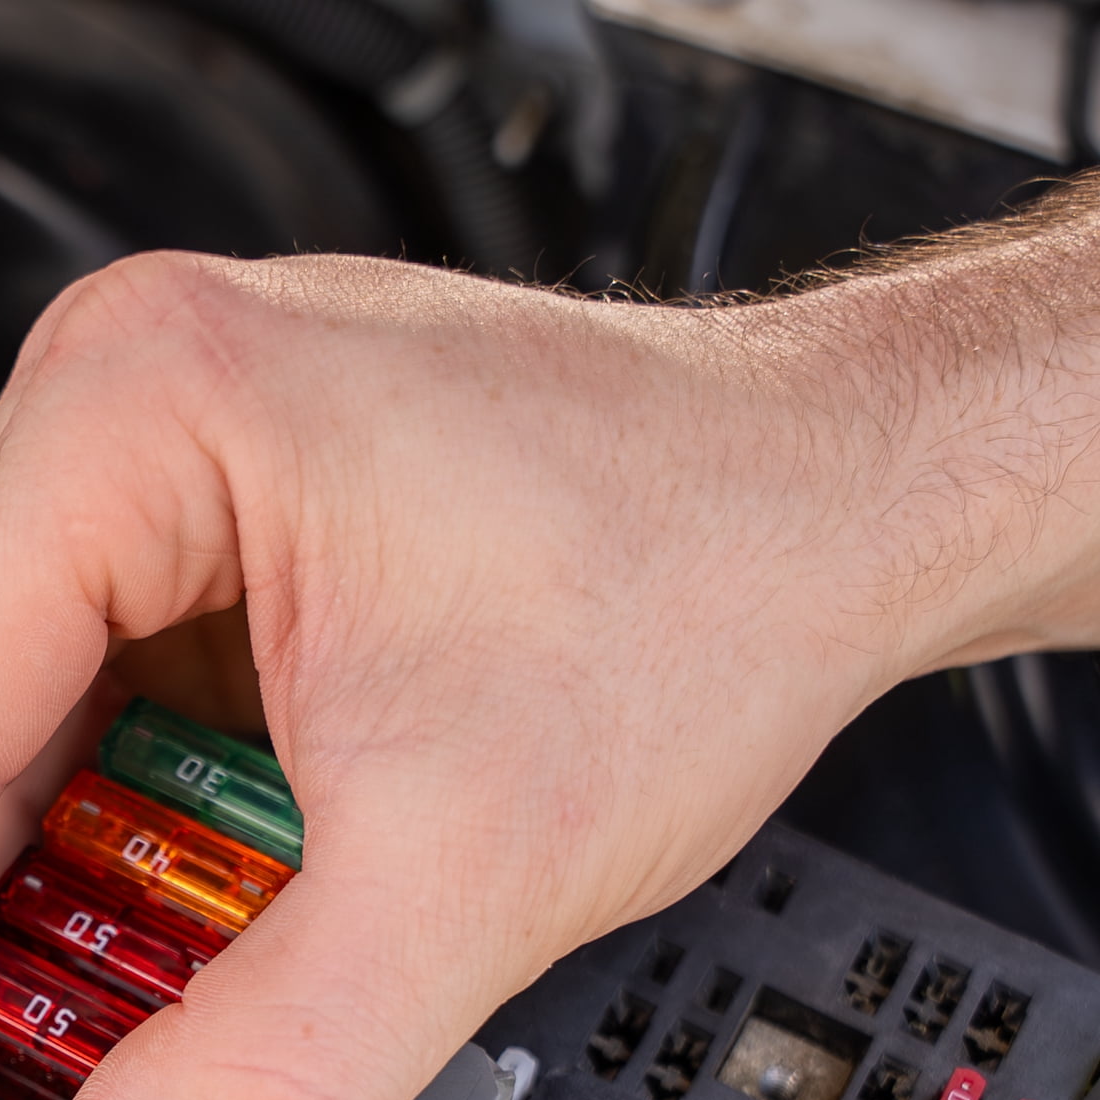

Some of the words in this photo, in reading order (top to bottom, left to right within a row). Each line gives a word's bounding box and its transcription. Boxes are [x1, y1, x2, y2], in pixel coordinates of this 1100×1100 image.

[175, 755, 229, 797] 30
[122, 835, 172, 875] 40
[63, 911, 119, 952] 50
[22, 994, 77, 1037] 50
